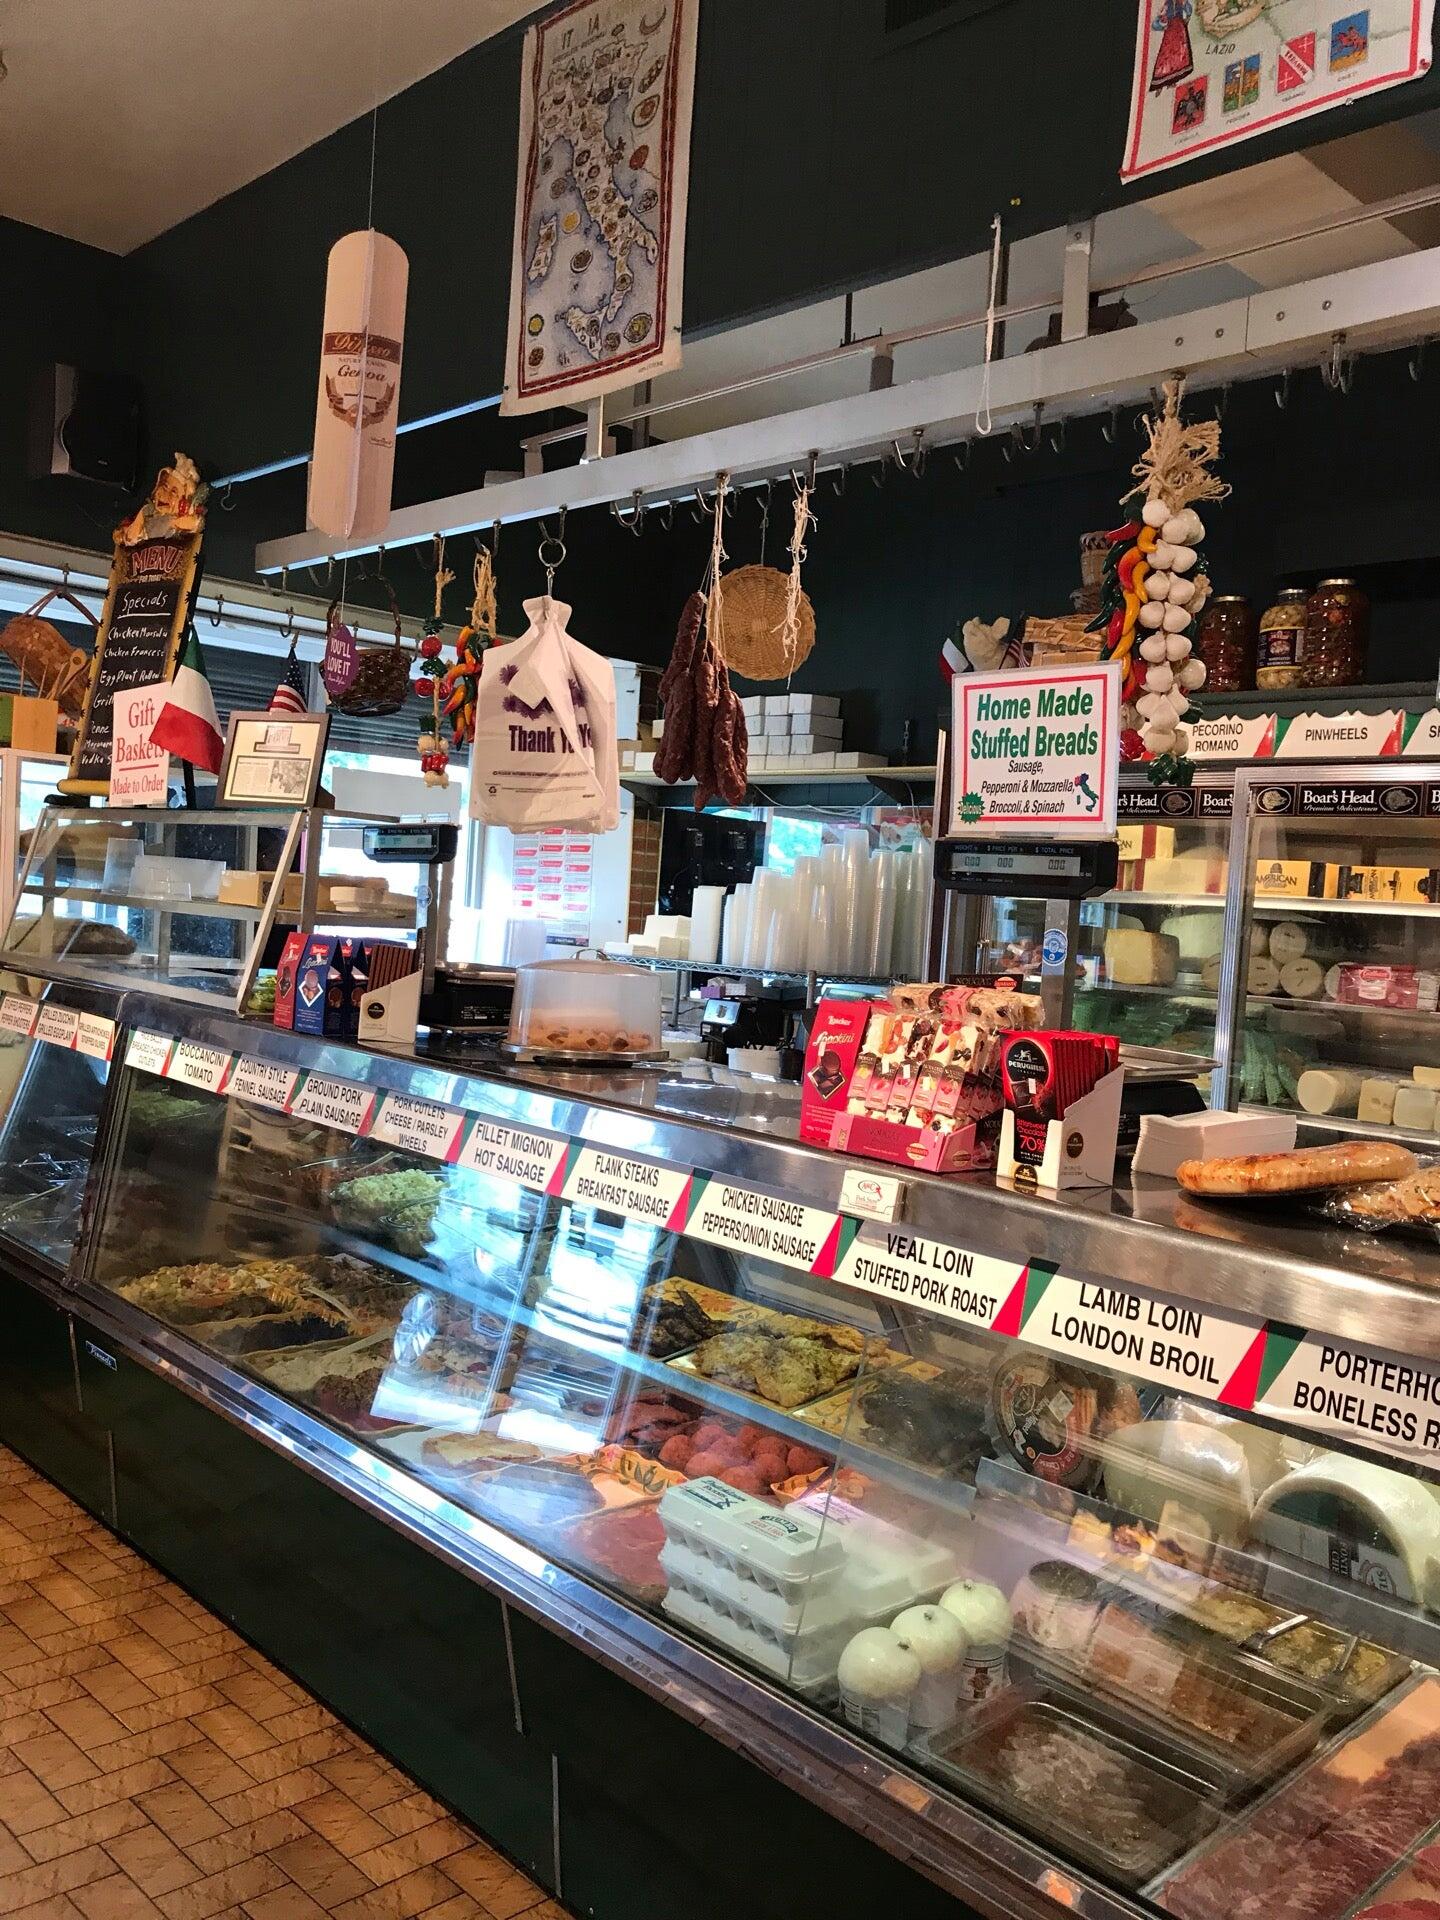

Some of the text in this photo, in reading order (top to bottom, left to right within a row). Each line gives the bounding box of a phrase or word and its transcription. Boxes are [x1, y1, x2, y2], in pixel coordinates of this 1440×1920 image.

[1206, 43, 1236, 54] LAZIO
[132, 546, 183, 577] MENU
[122, 590, 168, 615] Specials
[331, 638, 351, 658] YOU'LL
[328, 656, 350, 676] LOVE IT
[128, 698, 155, 728] Gift
[977, 687, 1094, 721] Home Made
[91, 721, 109, 734] enne
[509, 724, 555, 753] Thank
[1192, 723, 1244, 737] PECORINO
[1305, 728, 1368, 741] PINWHEELS
[115, 735, 165, 762] Baskets
[971, 724, 1099, 760] Stuffed Breads
[1195, 740, 1239, 752] ROMANO
[1008, 760, 1044, 775] Sausage,
[112, 774, 164, 795] Made to Order
[981, 778, 1075, 796] Pepperoni & Mozzarella,
[1303, 790, 1375, 803] Boar's Head
[1031, 801, 1065, 815] Spinach
[1130, 794, 1157, 806] Head
[1203, 794, 1234, 807] Boar's
[179, 1043, 225, 1067] BOCCANCINI
[184, 1063, 213, 1084] TOMATO
[240, 1059, 288, 1084] COUNTRY STYLE
[233, 1077, 286, 1105] FENNEL SAUSAGE
[307, 1078, 364, 1106] GROUND PORK
[300, 1100, 360, 1129] PLAIN SAUSAGE
[393, 1095, 446, 1120] PORK CUTLETS
[384, 1112, 411, 1129] CHEESE
[417, 1121, 448, 1139] PARSLEY
[399, 1133, 427, 1153] WHEELS
[476, 1123, 554, 1160] FILLET MIGNON
[1020, 1135, 1045, 1152] 70%
[474, 1151, 545, 1184] HOT SAUSAGE
[595, 1154, 660, 1188] FLANK STEAKS
[577, 1177, 670, 1219] BREAKFAST SAUSAGE
[722, 1188, 805, 1227] CHICKEN SAUSAGE
[701, 1211, 816, 1263] PEPPERS/ONION SAUSAGE
[887, 1232, 974, 1278] VEAL LOIN
[854, 1258, 998, 1321] STUFFED PORK ROAST
[1078, 1282, 1203, 1339] LAMB LOIN
[1051, 1312, 1220, 1385] LONDON BROIL
[1294, 1381, 1419, 1443] BONELESS
